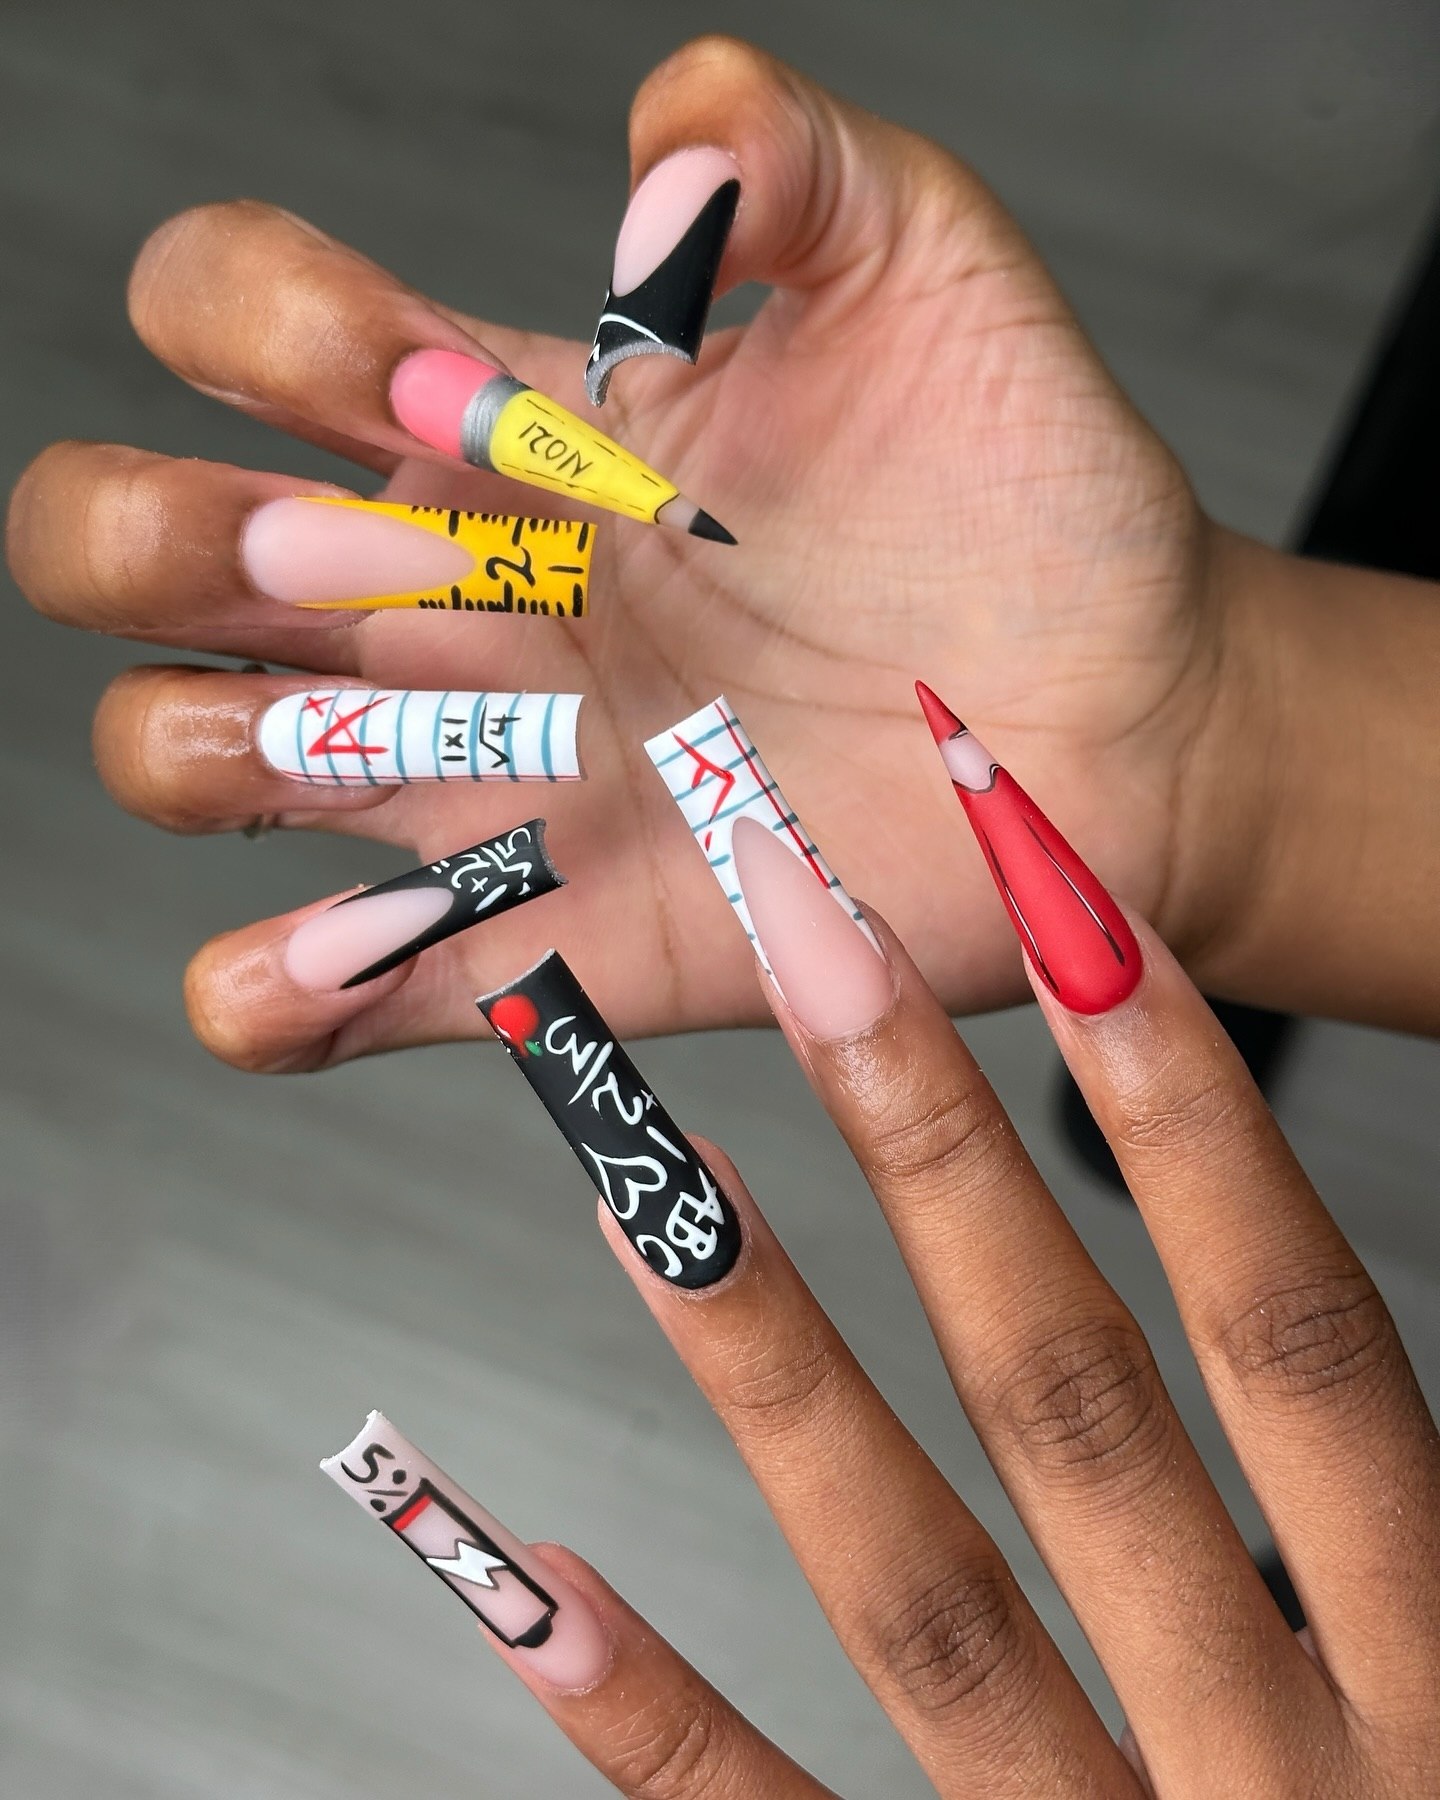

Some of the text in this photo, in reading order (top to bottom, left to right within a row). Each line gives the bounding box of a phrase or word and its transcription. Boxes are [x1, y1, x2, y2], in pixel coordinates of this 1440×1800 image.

[485, 546, 536, 587] 2
[636, 1167, 726, 1278] ABC
[340, 1442, 409, 1513] 5%
